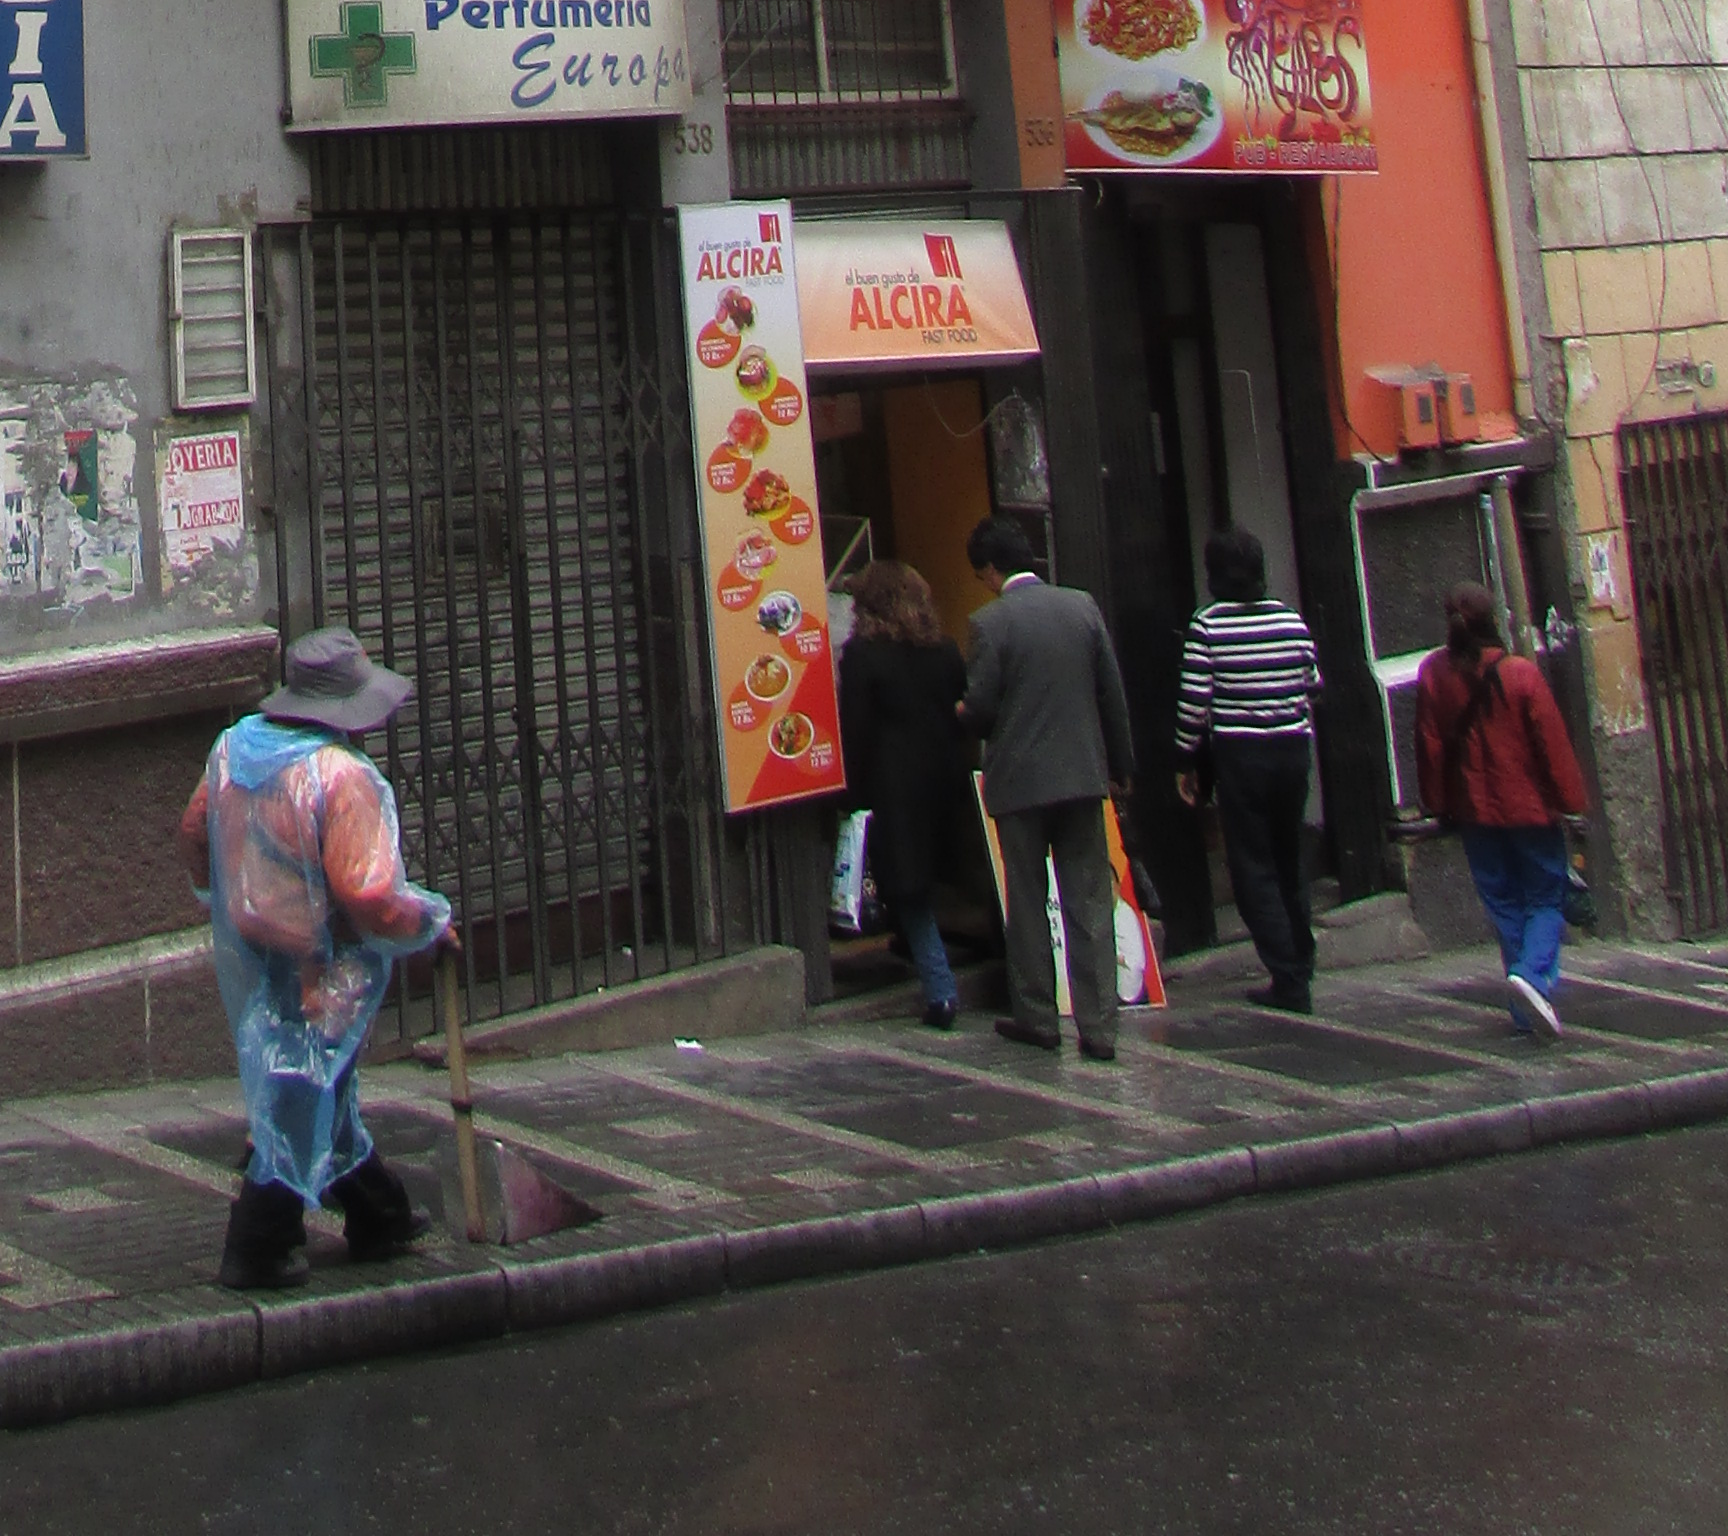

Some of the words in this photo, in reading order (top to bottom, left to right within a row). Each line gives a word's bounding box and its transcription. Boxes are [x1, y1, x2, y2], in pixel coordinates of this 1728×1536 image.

[510, 32, 685, 108] Europa
[674, 122, 713, 154] 538
[1233, 141, 1267, 165] PUB
[696, 247, 783, 282] ALCIRA
[845, 268, 853, 284] el
[855, 268, 879, 284] buen
[882, 271, 906, 288] gusto
[908, 267, 920, 283] de
[850, 284, 973, 331] ALCIRA
[922, 330, 944, 344] FAST
[948, 329, 978, 343] FOOD
